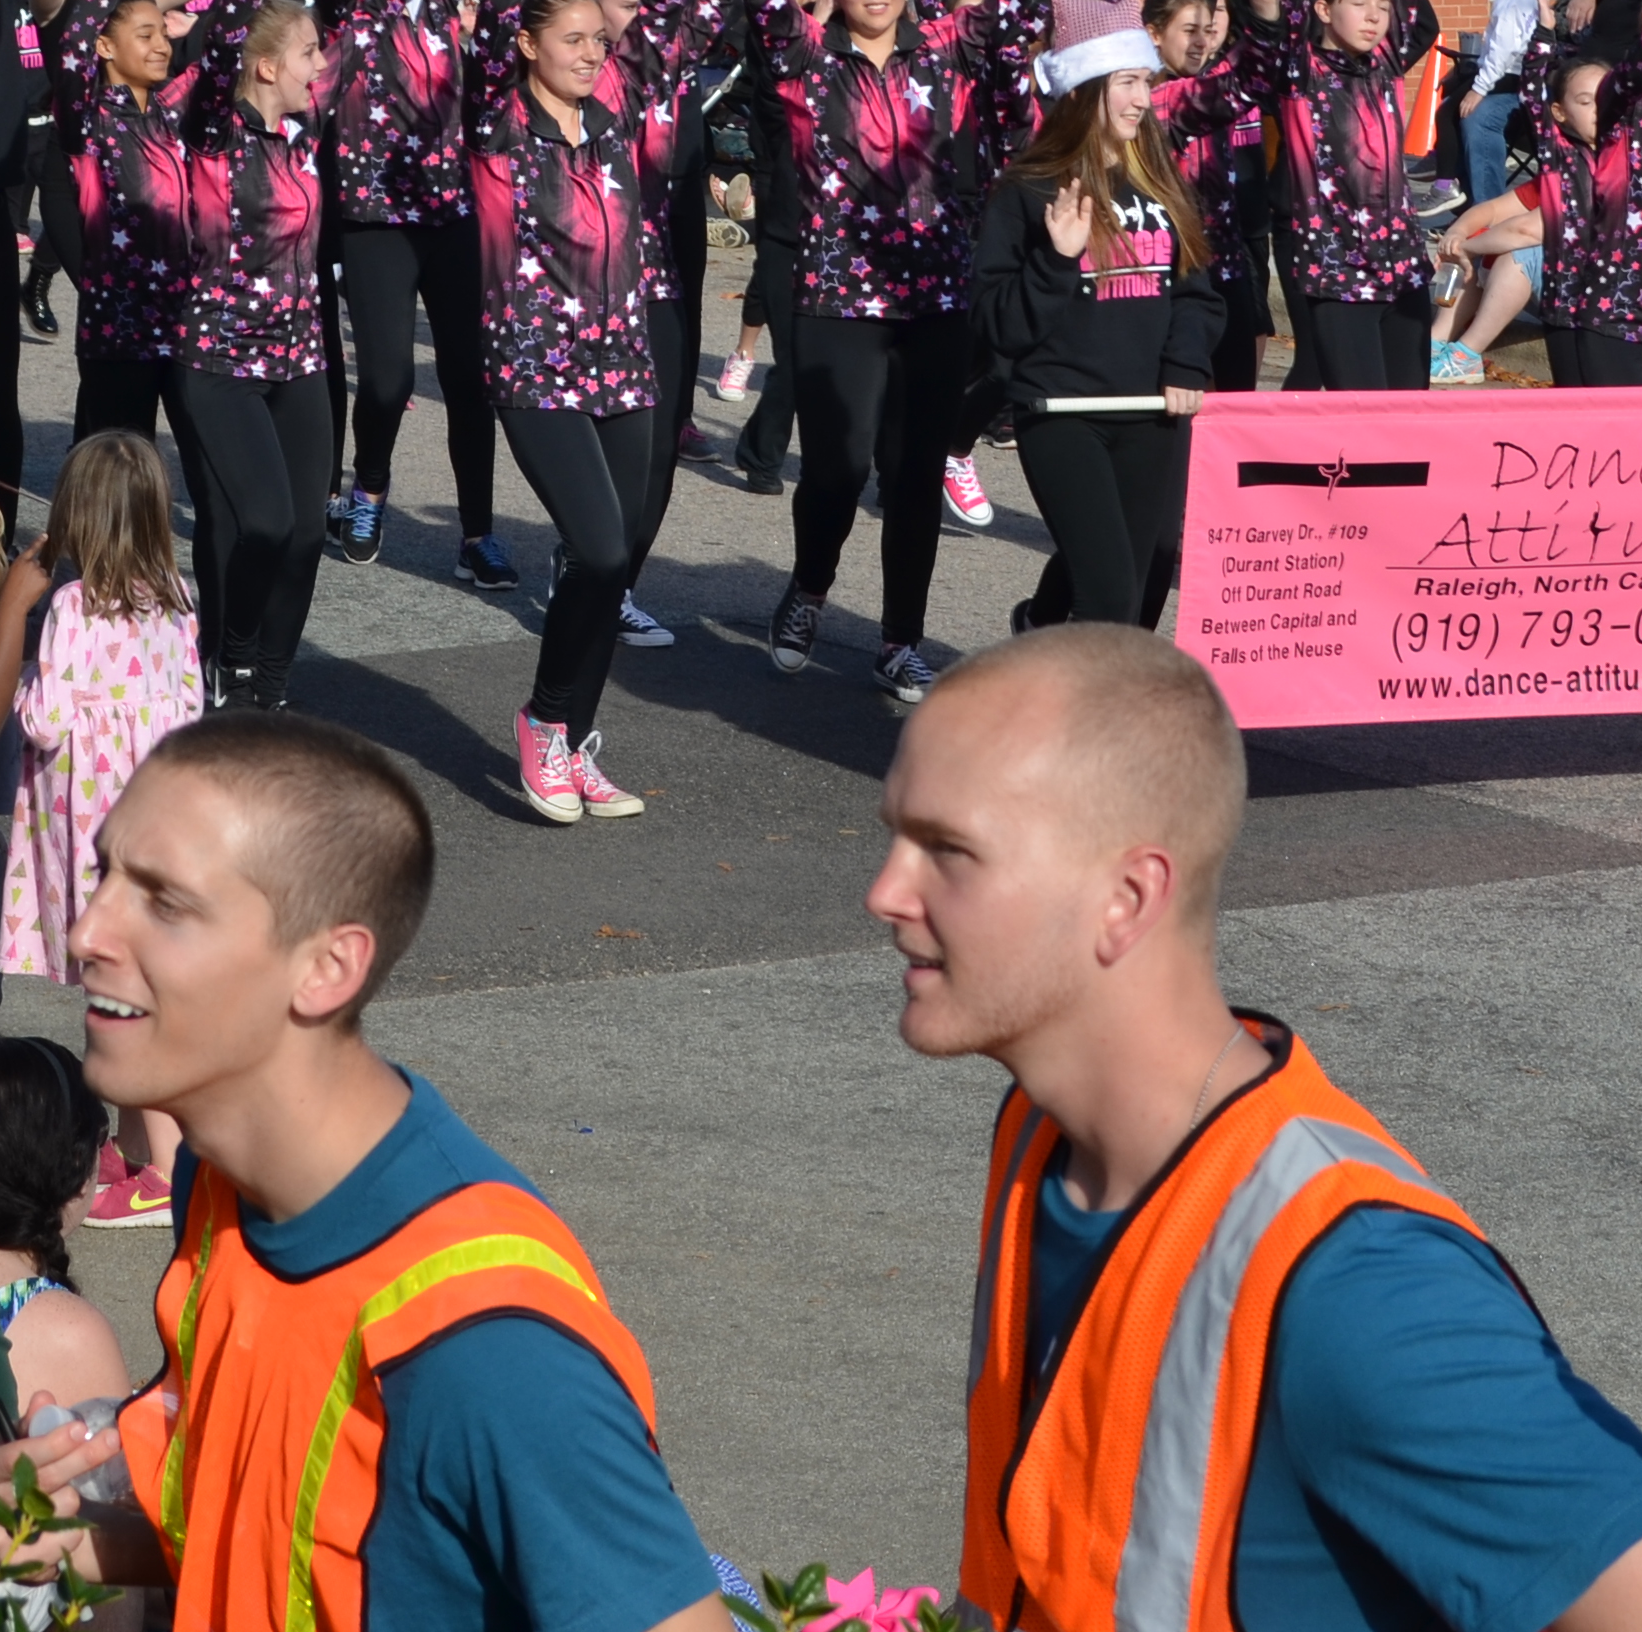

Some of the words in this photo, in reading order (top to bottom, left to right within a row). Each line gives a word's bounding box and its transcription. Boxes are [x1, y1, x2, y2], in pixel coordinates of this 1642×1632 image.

[1208, 527, 1241, 545] 8471
[1245, 527, 1293, 545] Garvey
[1298, 523, 1322, 540] Dr.,
[1328, 524, 1369, 540] #109
[1222, 556, 1280, 577] (Durant
[1284, 552, 1345, 572] Station)
[1221, 586, 1242, 604] Off
[1246, 585, 1299, 602] Durant
[1303, 580, 1342, 599] Road
[1414, 576, 1524, 601] Raleigh,
[1533, 573, 1609, 594] North
[1201, 618, 1266, 635] Between
[1270, 611, 1323, 633] Capital
[1327, 609, 1357, 627] and
[1392, 612, 1500, 664] (919)
[1211, 647, 1246, 664] Falls
[1250, 645, 1264, 663] of
[1267, 644, 1290, 660] the
[1294, 641, 1343, 658] Neuse
